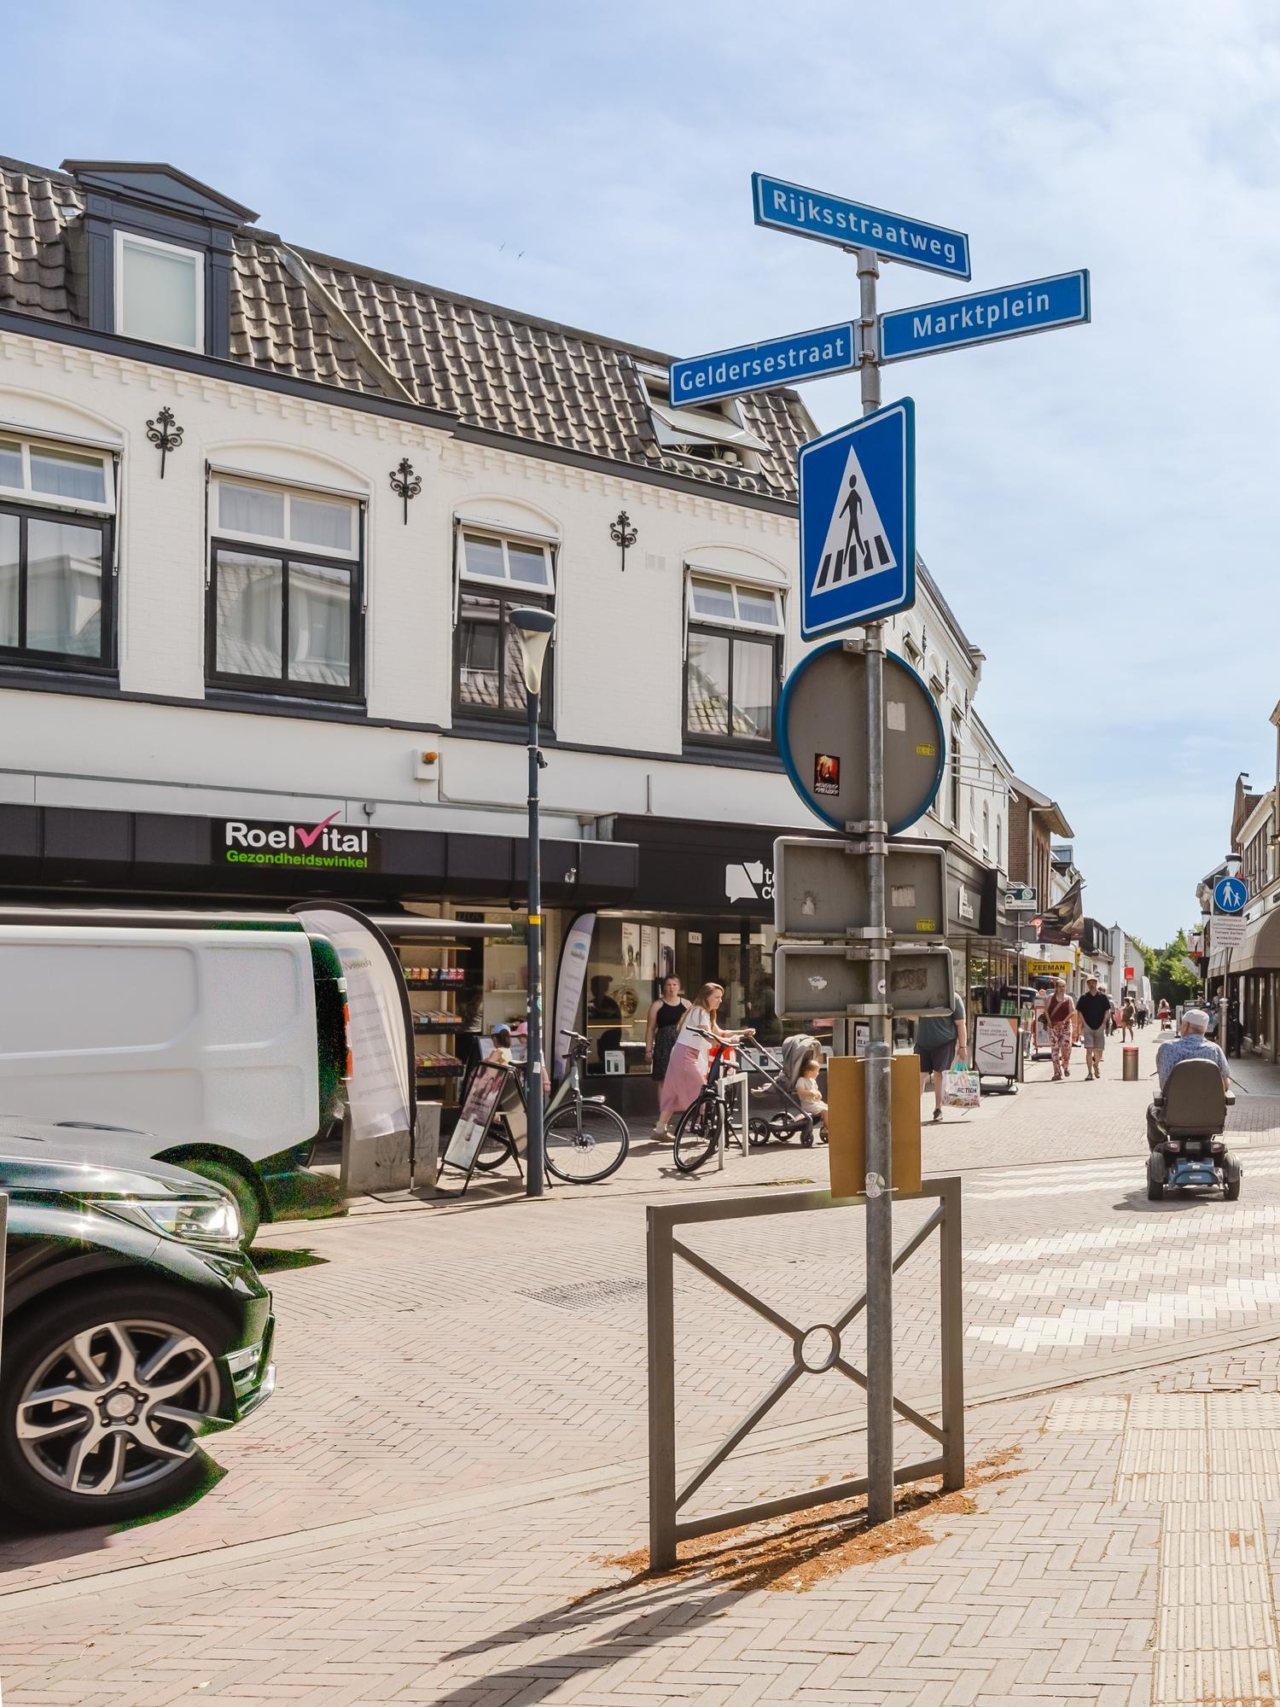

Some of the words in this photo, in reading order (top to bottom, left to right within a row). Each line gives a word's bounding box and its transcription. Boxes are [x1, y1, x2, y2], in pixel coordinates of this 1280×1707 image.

[774, 190, 956, 264] Rijksstraatweg
[913, 291, 1050, 339] Marktplein
[680, 337, 845, 391] Geldersestraat
[225, 811, 368, 853] RoelVital
[226, 850, 368, 868] Gezondheidswinkel
